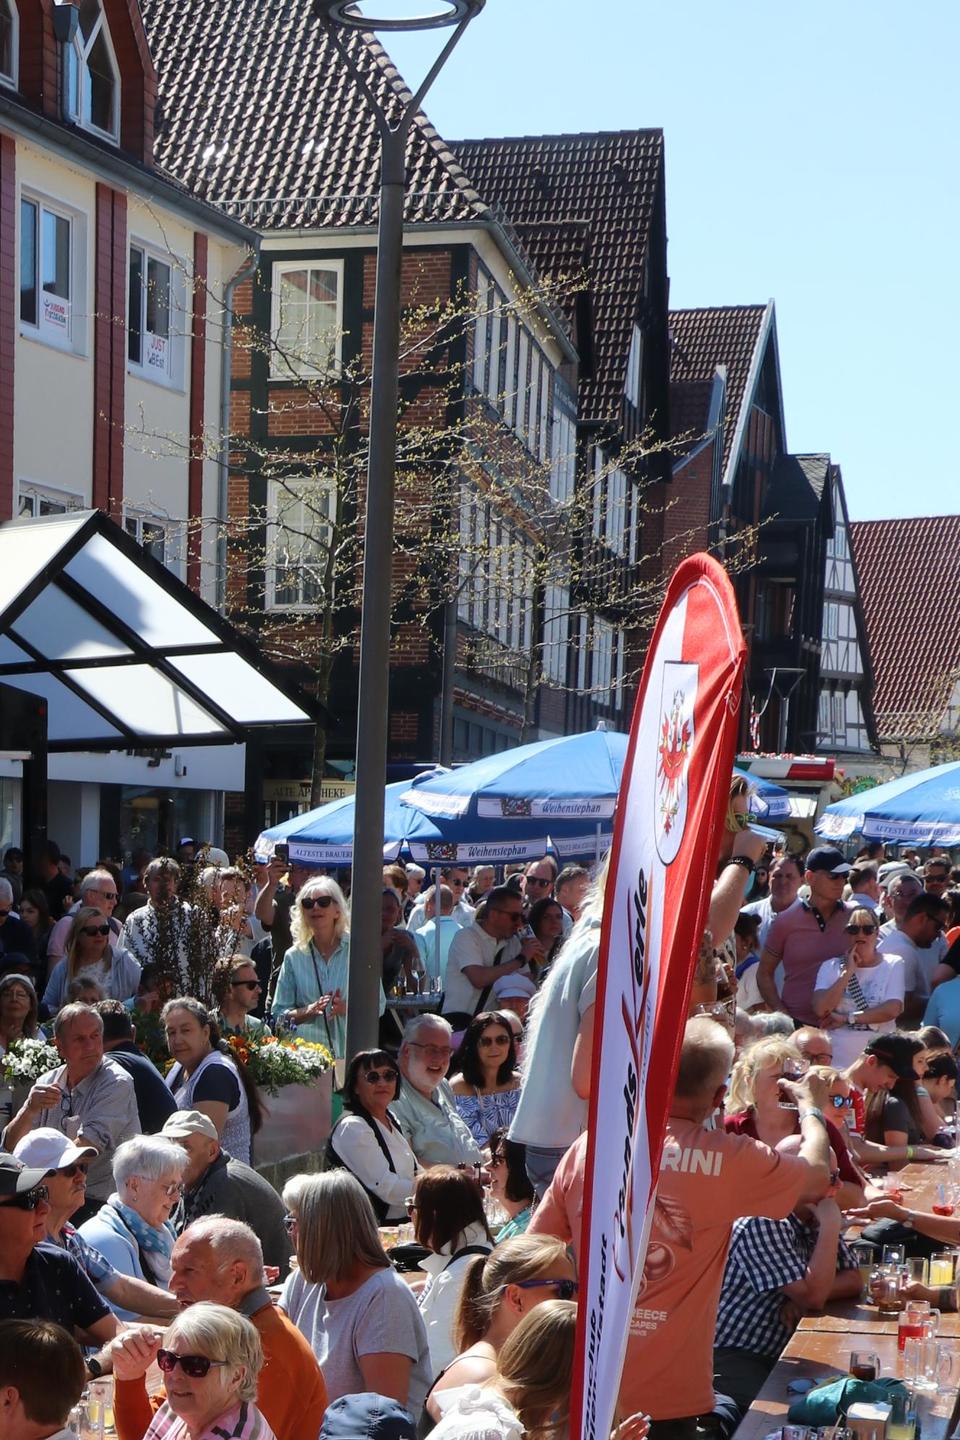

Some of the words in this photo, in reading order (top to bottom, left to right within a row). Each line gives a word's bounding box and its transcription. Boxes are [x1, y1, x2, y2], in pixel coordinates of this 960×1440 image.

[299, 787, 346, 799] APHEKE
[542, 802, 601, 815] Weihenstephan
[468, 844, 527, 858] Weihenstephan
[660, 1145, 723, 1177] RINI
